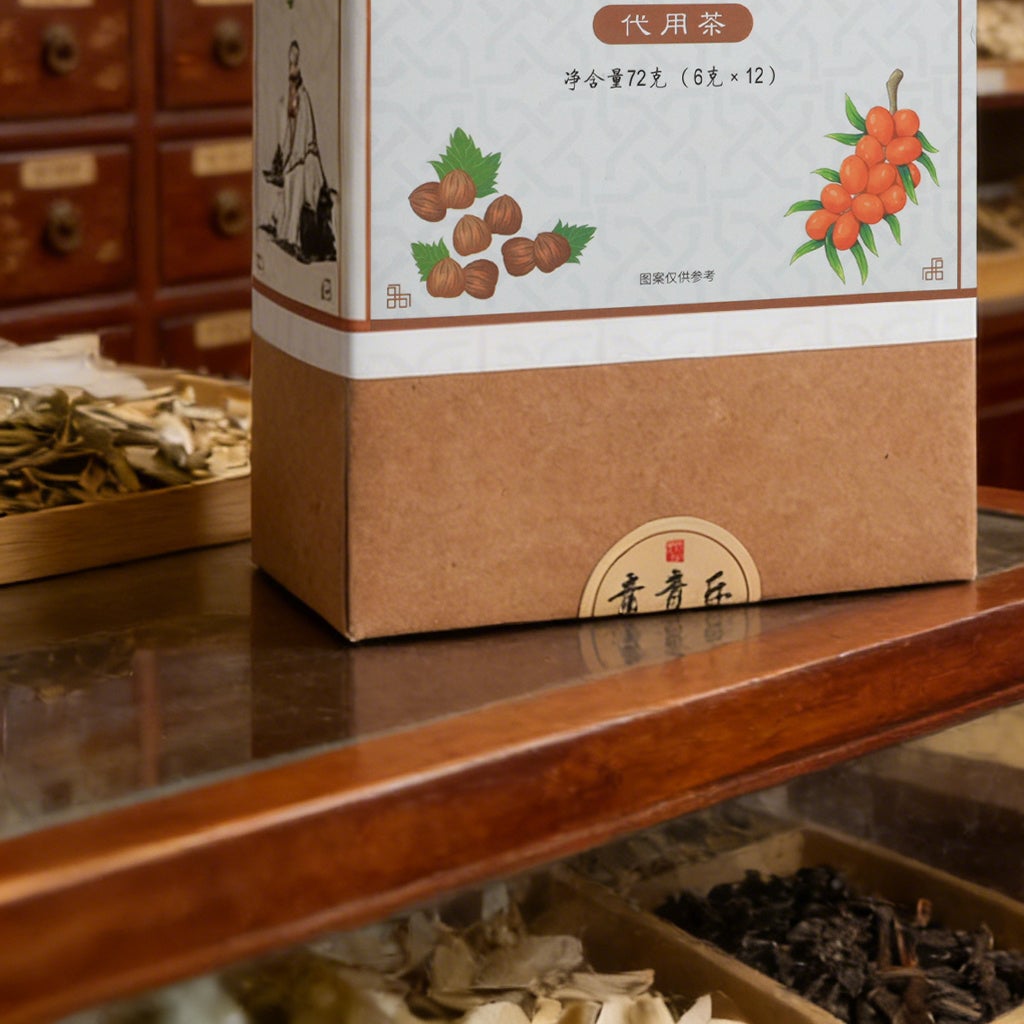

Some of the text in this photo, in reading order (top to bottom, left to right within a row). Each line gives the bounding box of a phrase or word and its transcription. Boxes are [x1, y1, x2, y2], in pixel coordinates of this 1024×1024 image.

[620, 11, 726, 37] 代用茶
[639, 270, 716, 286] 图案仅供参考
